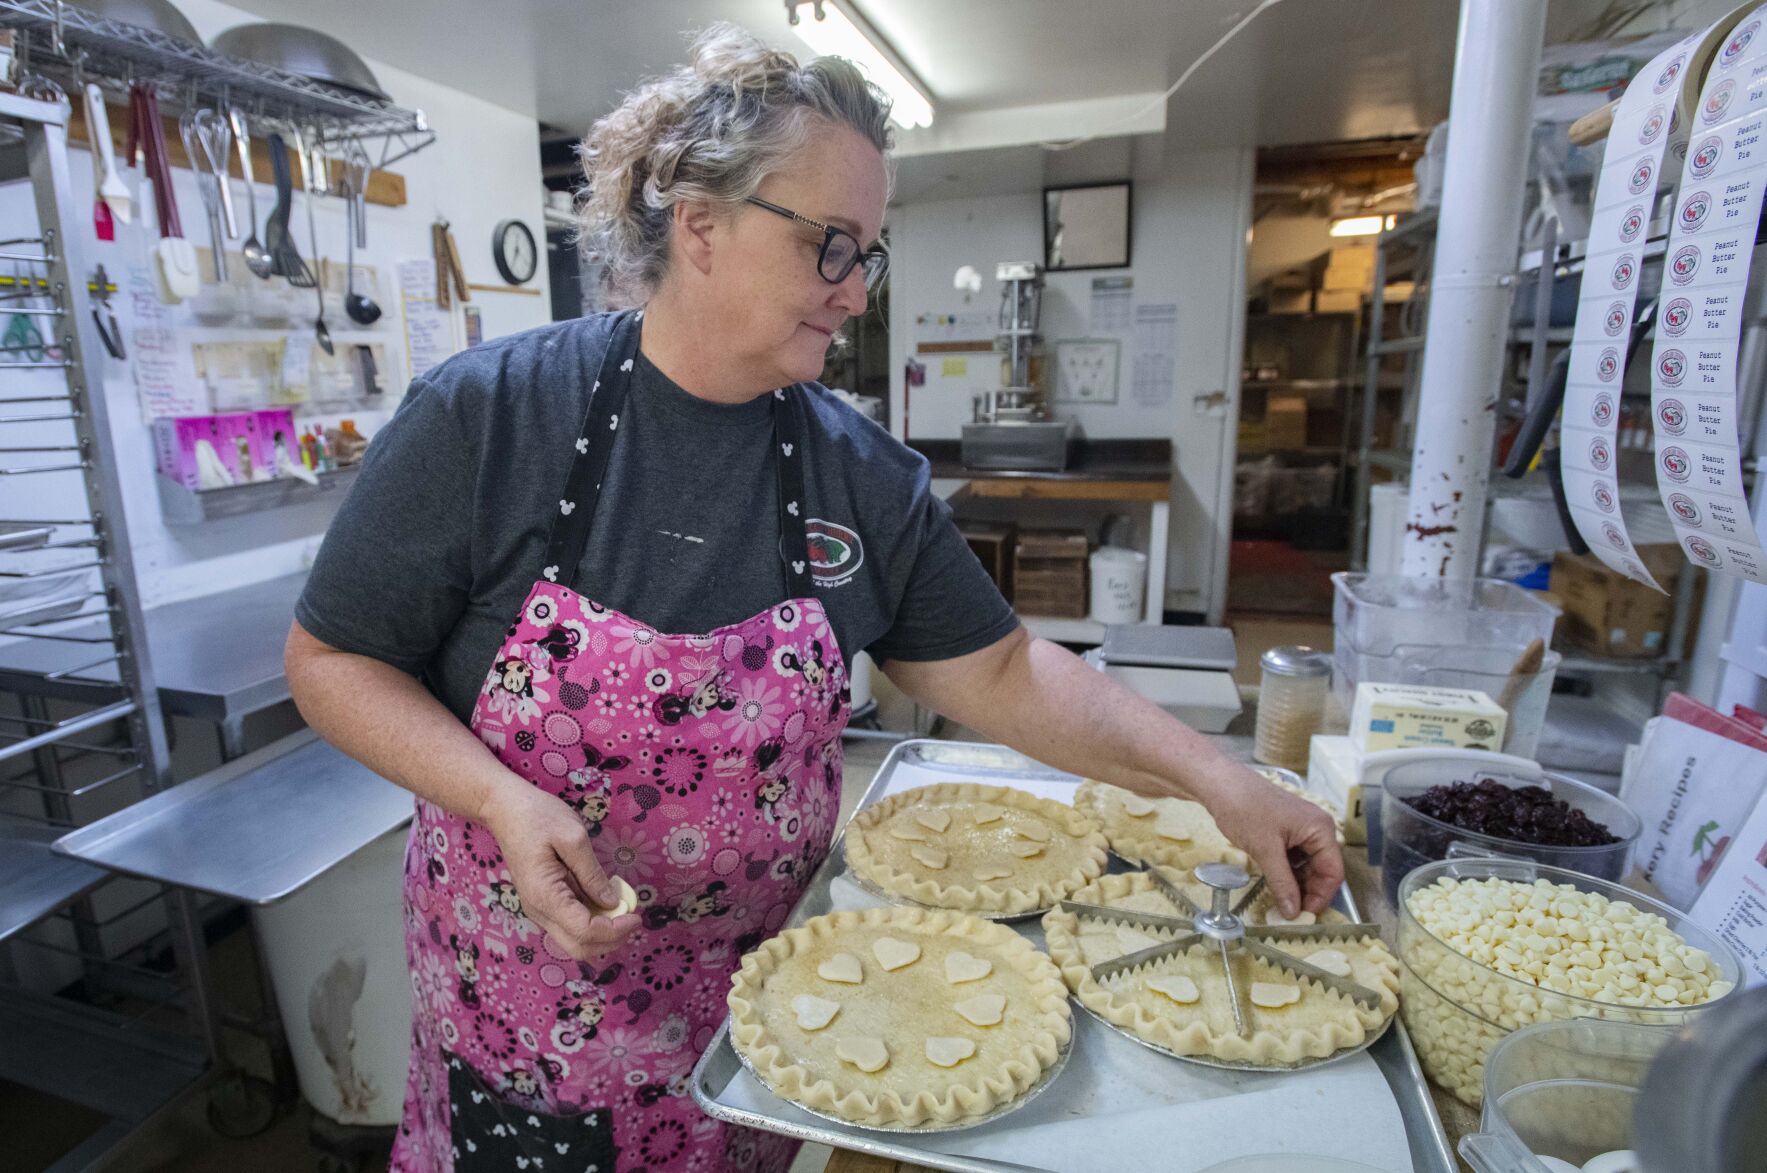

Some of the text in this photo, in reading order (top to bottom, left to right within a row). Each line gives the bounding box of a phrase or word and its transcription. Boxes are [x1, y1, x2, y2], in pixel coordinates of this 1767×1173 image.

[1737, 121, 1762, 136] Peanut
[1726, 181, 1751, 194] Peanut
[1722, 195, 1748, 207] Butter
[1726, 209, 1739, 218] Pie
[1714, 239, 1738, 250] Peanut
[1711, 252, 1736, 263] Butter
[1715, 265, 1728, 274] Pie
[1705, 296, 1728, 305] Peanut
[1703, 308, 1727, 317] Butter
[1707, 321, 1719, 329] Pie
[1699, 351, 1722, 359] Peanut
[1698, 363, 1721, 371] Butter
[1703, 374, 1715, 383] Pie
[1698, 403, 1721, 413] Peanut
[1698, 414, 1721, 424] Butter
[1704, 426, 1717, 435] Pie
[1701, 453, 1725, 465] Peanut
[1702, 464, 1725, 476] Butter
[1709, 476, 1721, 486] Pie
[1659, 756, 1697, 836] Recipes
